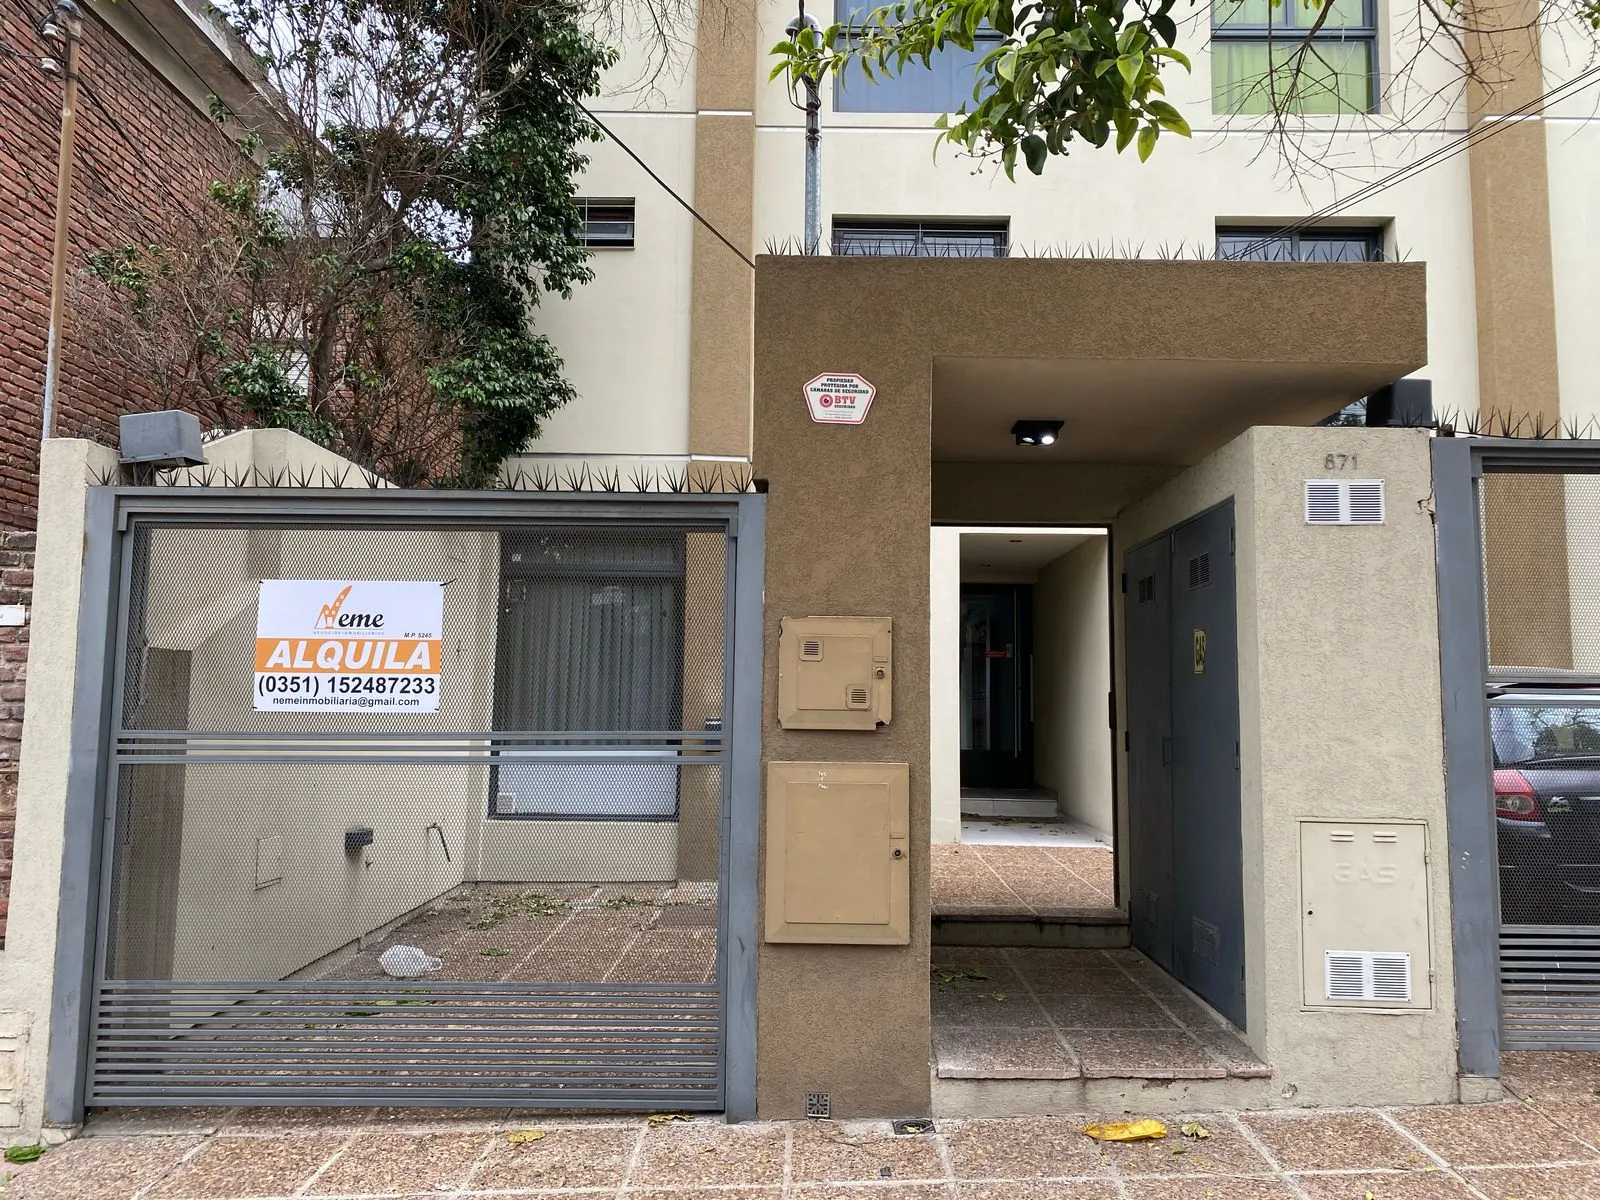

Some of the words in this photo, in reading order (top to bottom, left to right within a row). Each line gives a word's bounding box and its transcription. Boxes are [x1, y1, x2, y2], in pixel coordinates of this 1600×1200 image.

[834, 396, 856, 404] BTV
[264, 640, 431, 671] ALQUILA
[258, 675, 320, 697] (0351)
[327, 676, 436, 694] 152487233
[272, 696, 420, 707] nemeinmobiliaria@gmail.com
[1333, 862, 1397, 885] GAS
